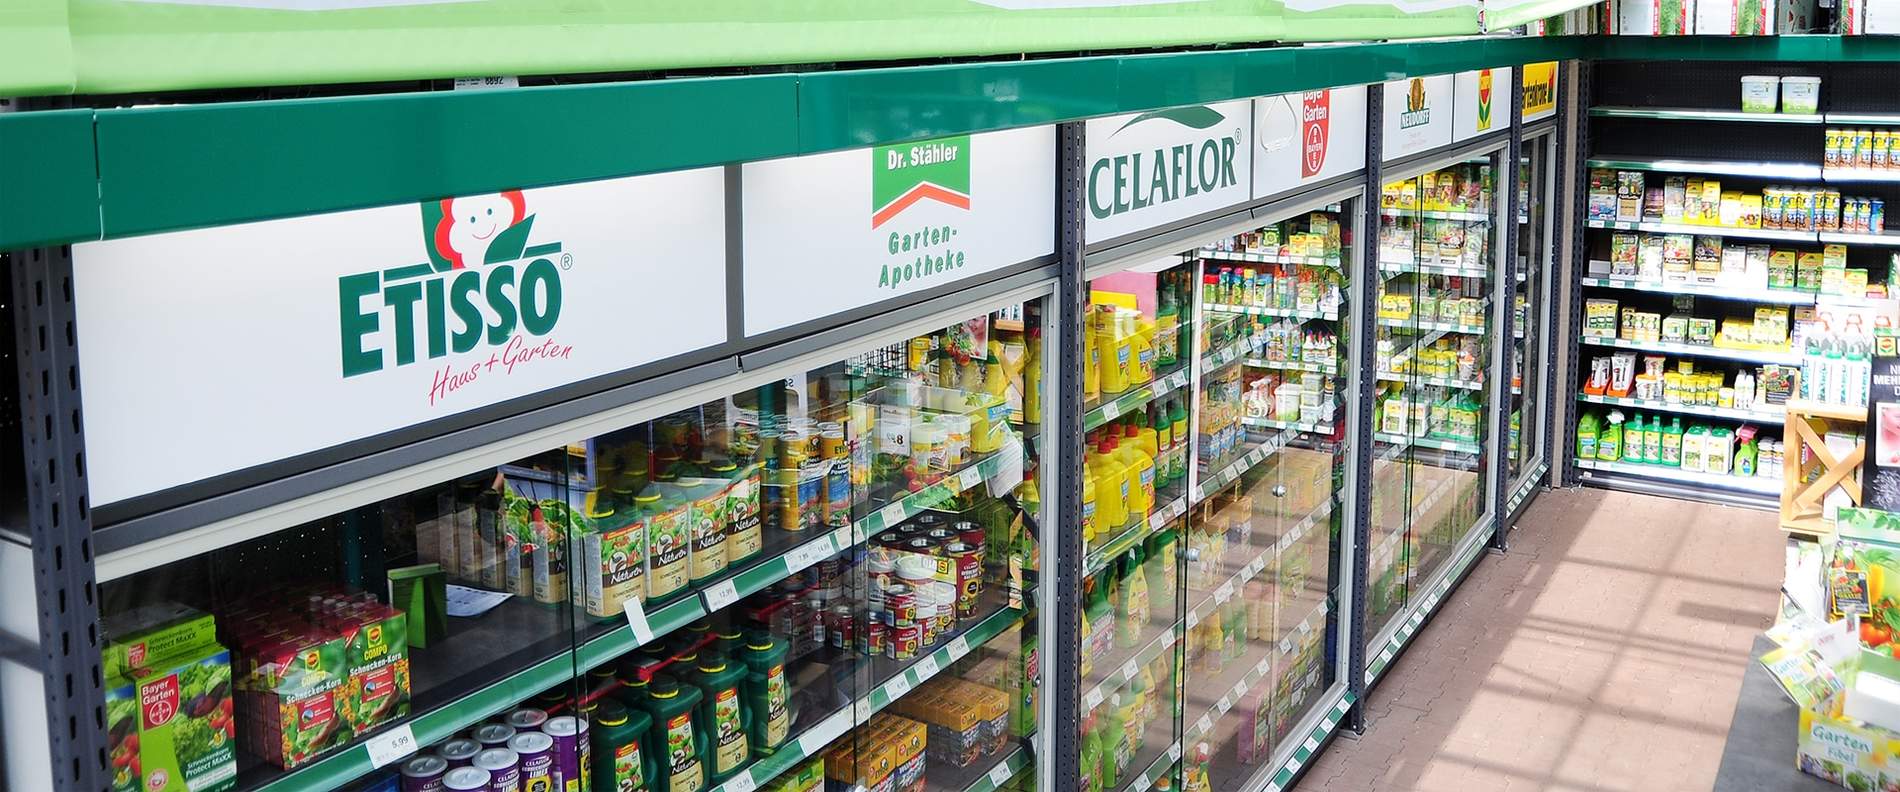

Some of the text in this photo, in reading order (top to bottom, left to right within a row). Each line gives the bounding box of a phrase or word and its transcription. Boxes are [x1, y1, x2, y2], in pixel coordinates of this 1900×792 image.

[1304, 104, 1327, 123] Garten
[887, 143, 958, 171] Dr. Stähler
[888, 225, 958, 255] Garten-
[878, 250, 965, 289] Apotheke
[428, 334, 573, 406] Haus + Garten
[349, 651, 402, 677] Schnecken-Korn
[364, 644, 388, 661] COMPO
[142, 680, 169, 697] Bayer
[143, 688, 175, 706] Garten
[391, 735, 409, 749] 5.99
[1812, 725, 1872, 753] Garten
